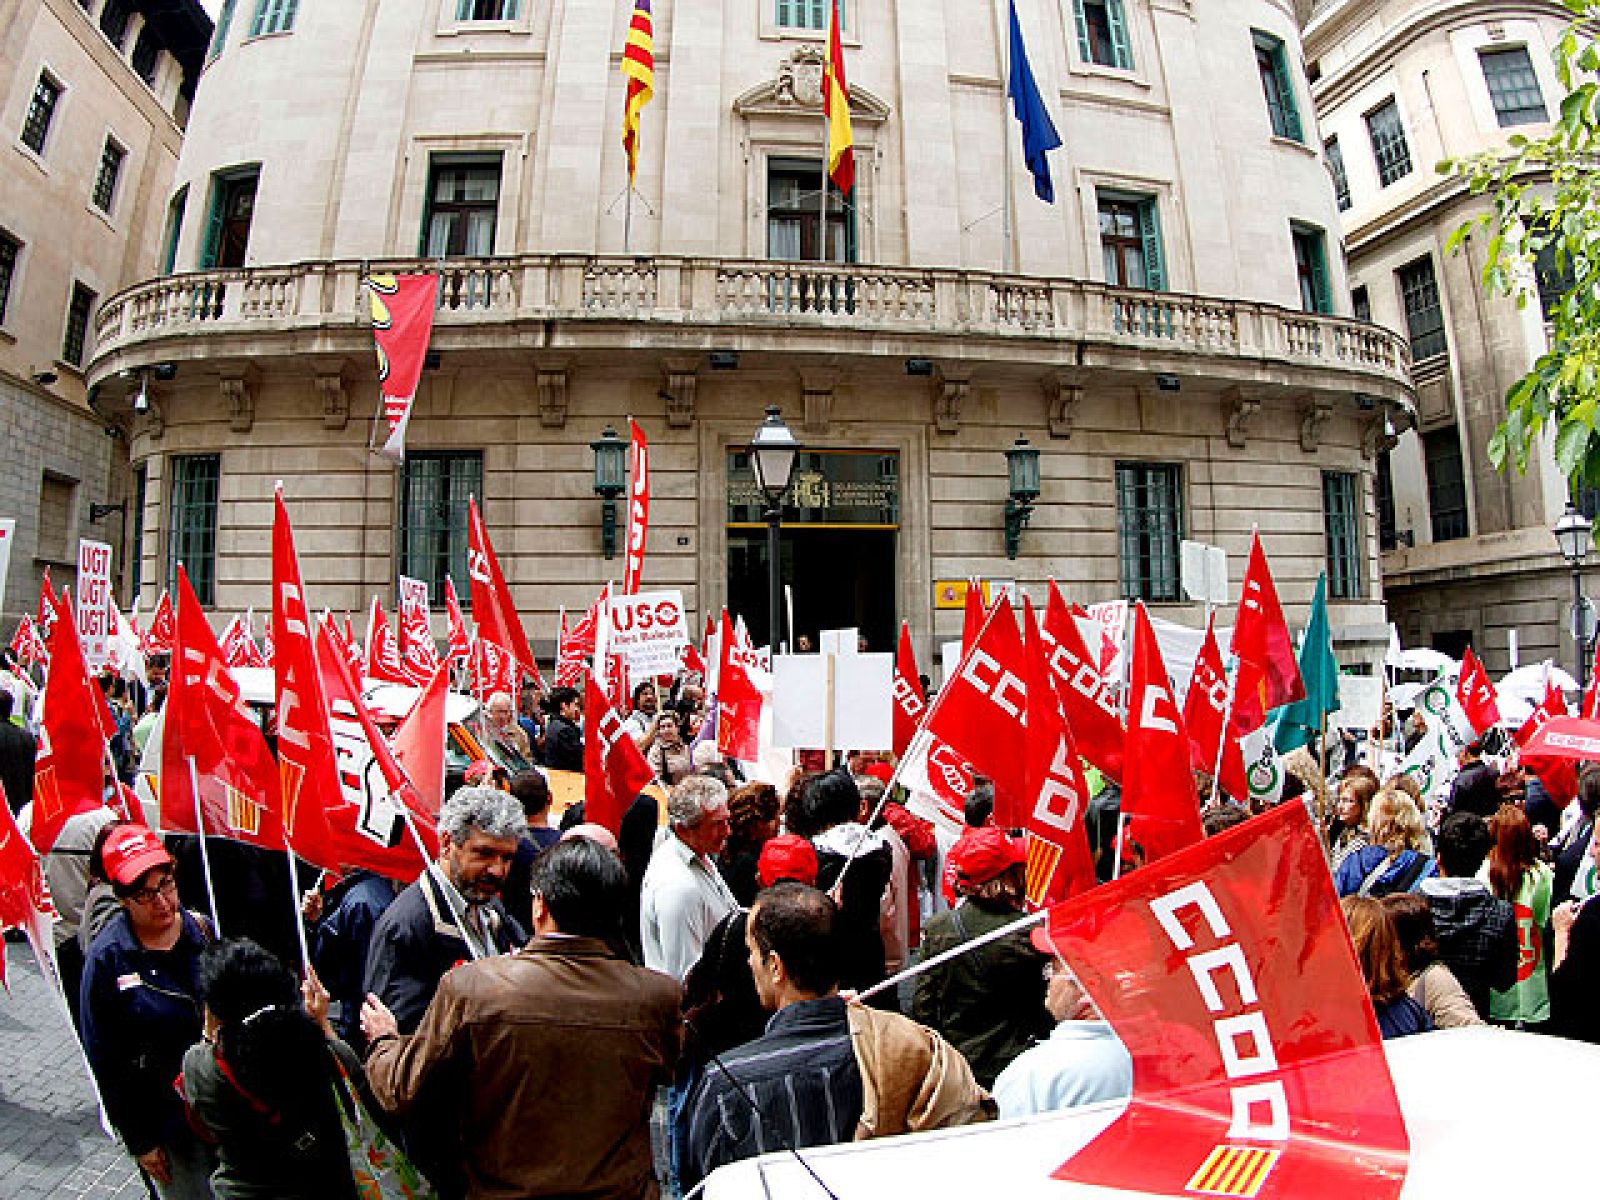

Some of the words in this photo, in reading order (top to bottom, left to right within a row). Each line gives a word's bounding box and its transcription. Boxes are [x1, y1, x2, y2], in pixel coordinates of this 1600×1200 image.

[81, 546, 109, 576] UGT
[81, 577, 108, 606] UGT
[79, 608, 106, 637] UGT
[612, 600, 681, 632] USO
[1149, 879, 1291, 1142] CCOO
